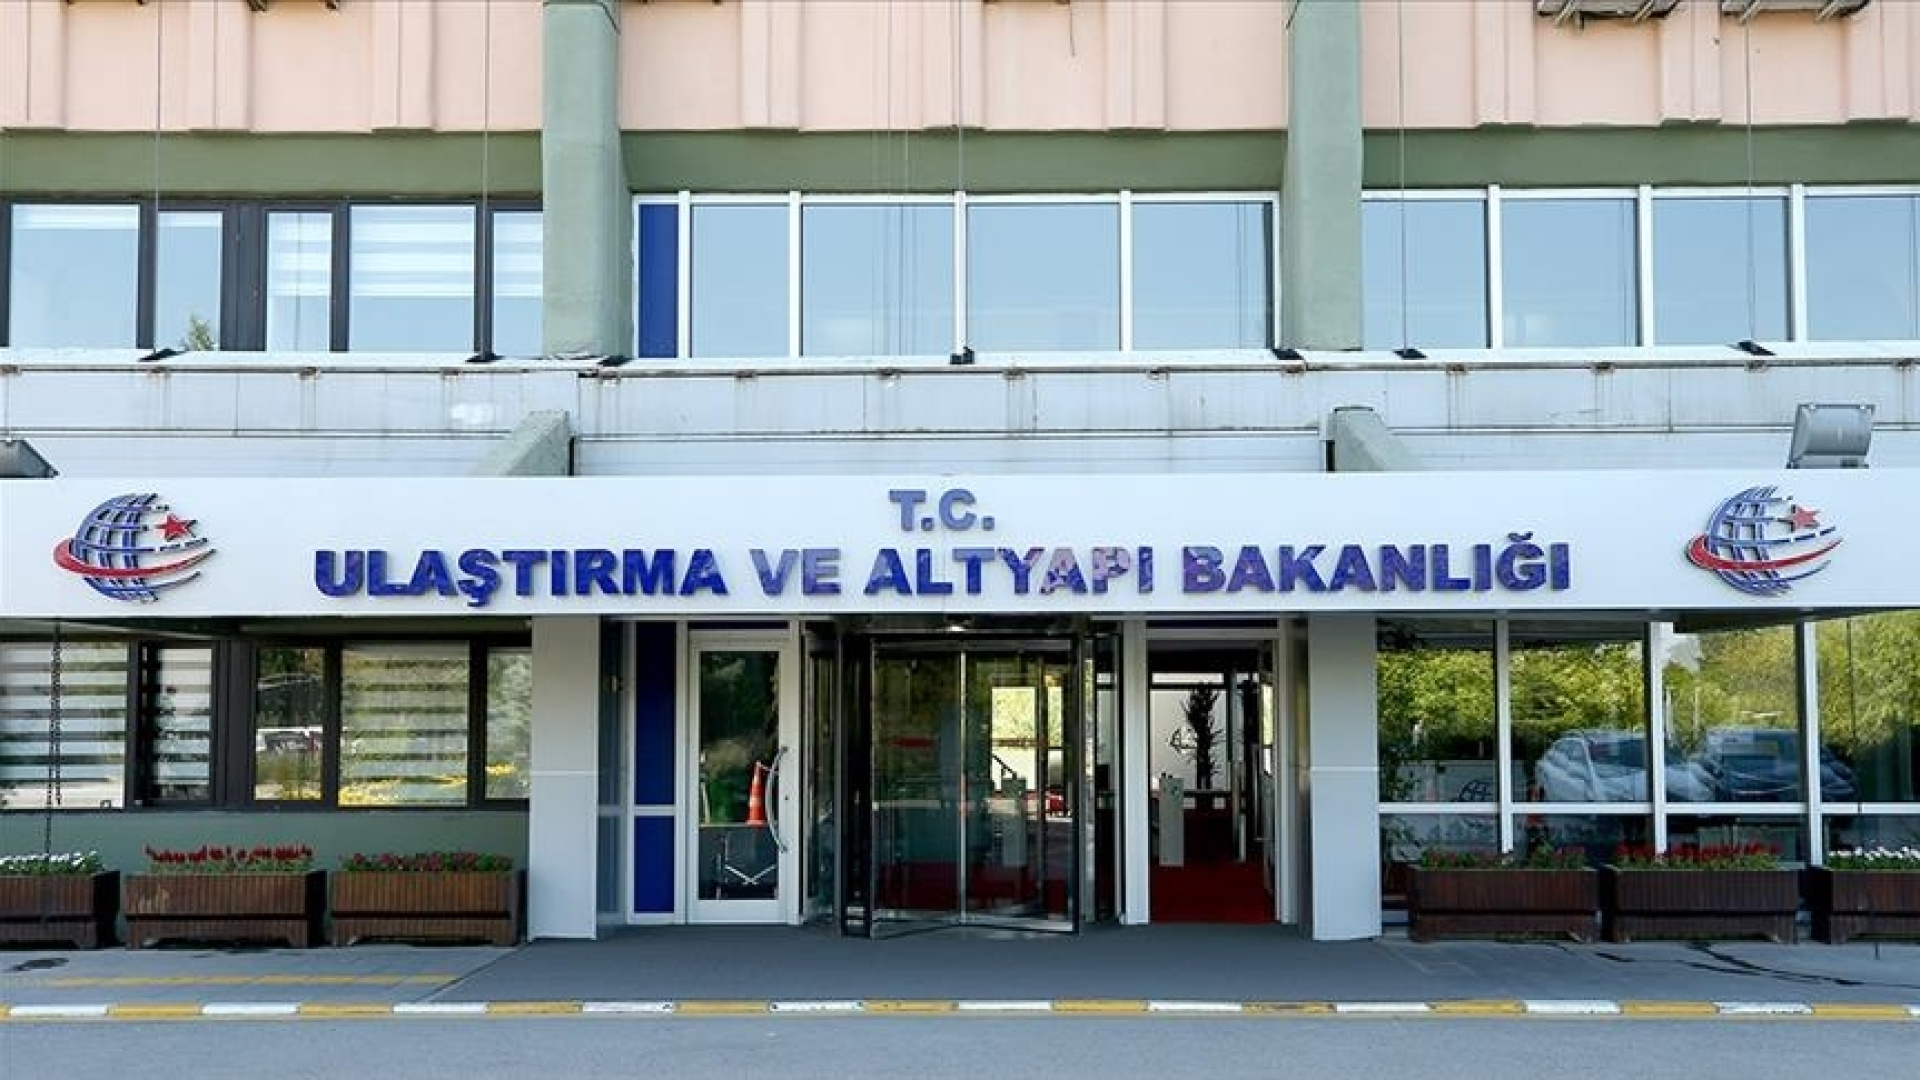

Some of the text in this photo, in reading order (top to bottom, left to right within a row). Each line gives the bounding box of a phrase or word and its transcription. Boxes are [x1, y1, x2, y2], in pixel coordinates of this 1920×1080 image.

[889, 489, 996, 531] T.C.
[315, 532, 1570, 607] ULAŞTIRMA VE ALTYAPI BAKANLIĞI
